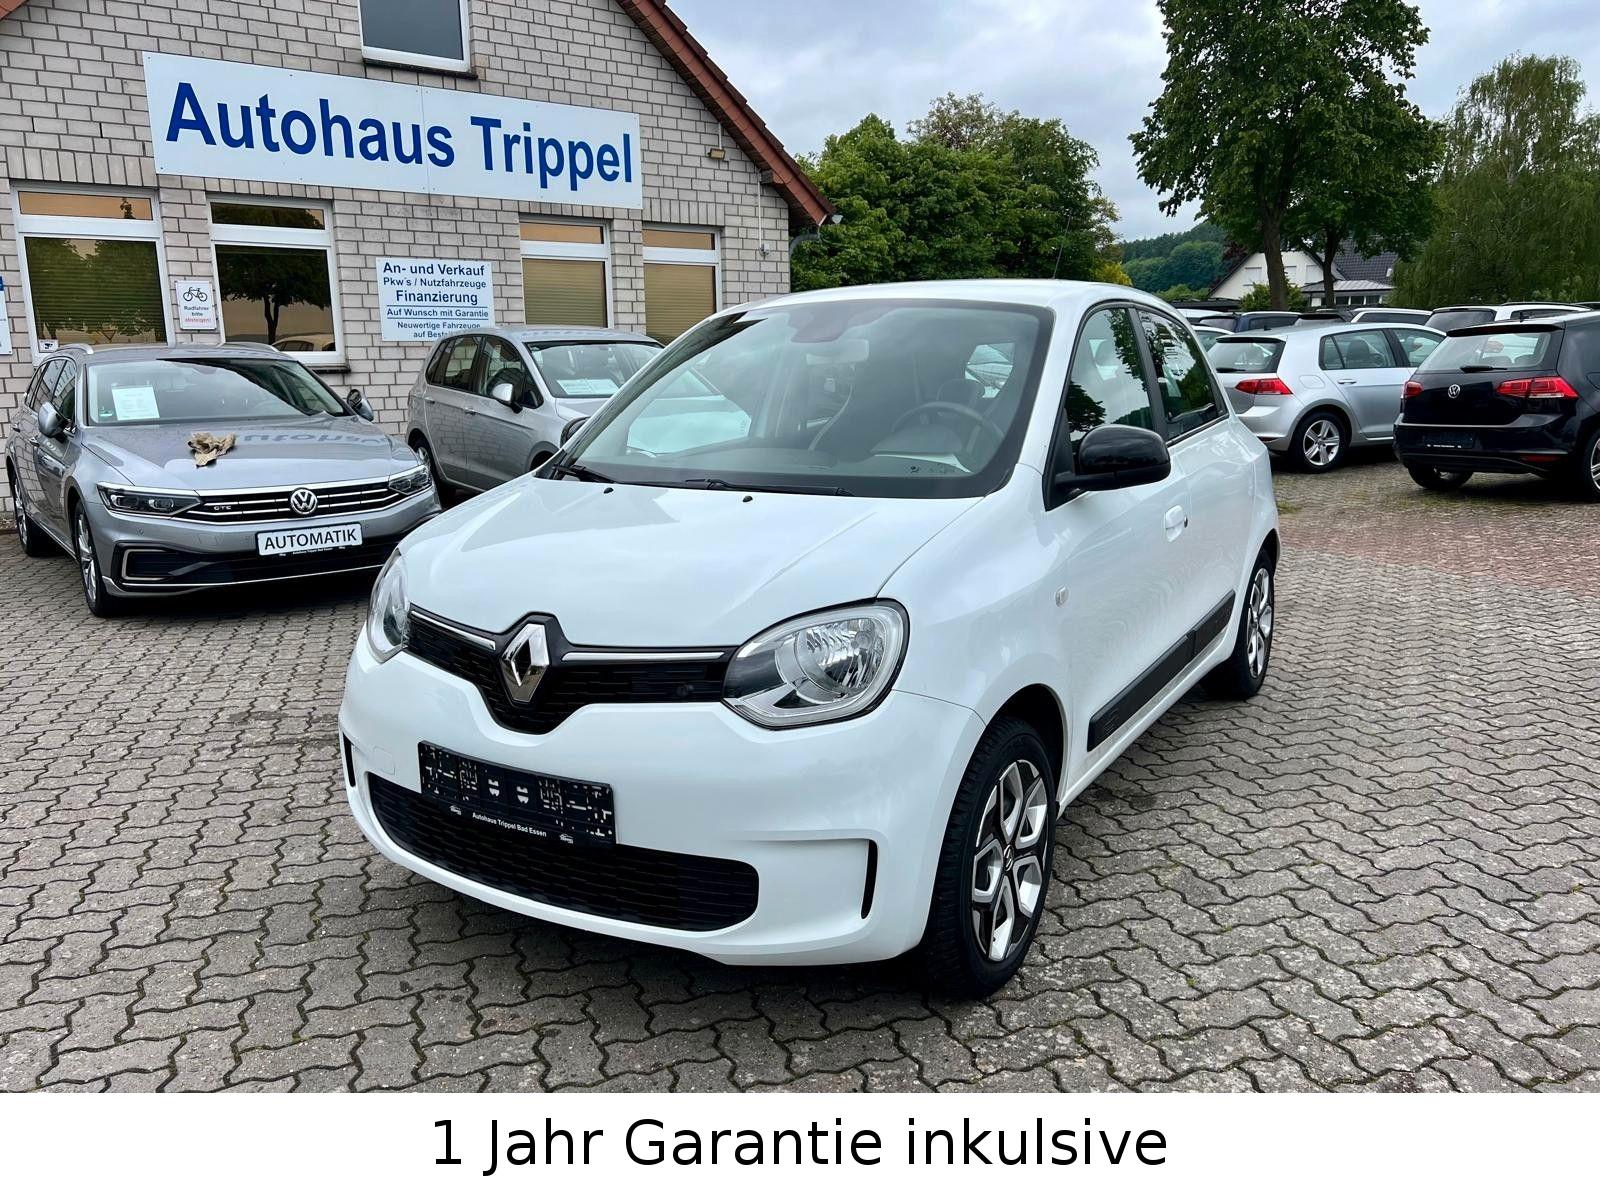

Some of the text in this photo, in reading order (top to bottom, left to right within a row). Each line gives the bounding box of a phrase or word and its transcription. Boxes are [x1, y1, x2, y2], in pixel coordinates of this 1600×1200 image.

[166, 82, 632, 191] Autohaus Trippel
[383, 262, 485, 276] An- und Verkauf
[420, 278, 486, 289] Nutzfahrzeuge
[396, 290, 478, 305] Finanzierung
[404, 309, 438, 317] Wunsch
[440, 309, 453, 317] mit
[455, 309, 489, 318] Garantie
[397, 321, 440, 329] Neuwertige
[264, 528, 357, 550] AUTOMATIK
[472, 812, 547, 837] Autohaus Trippel Bad Essen
